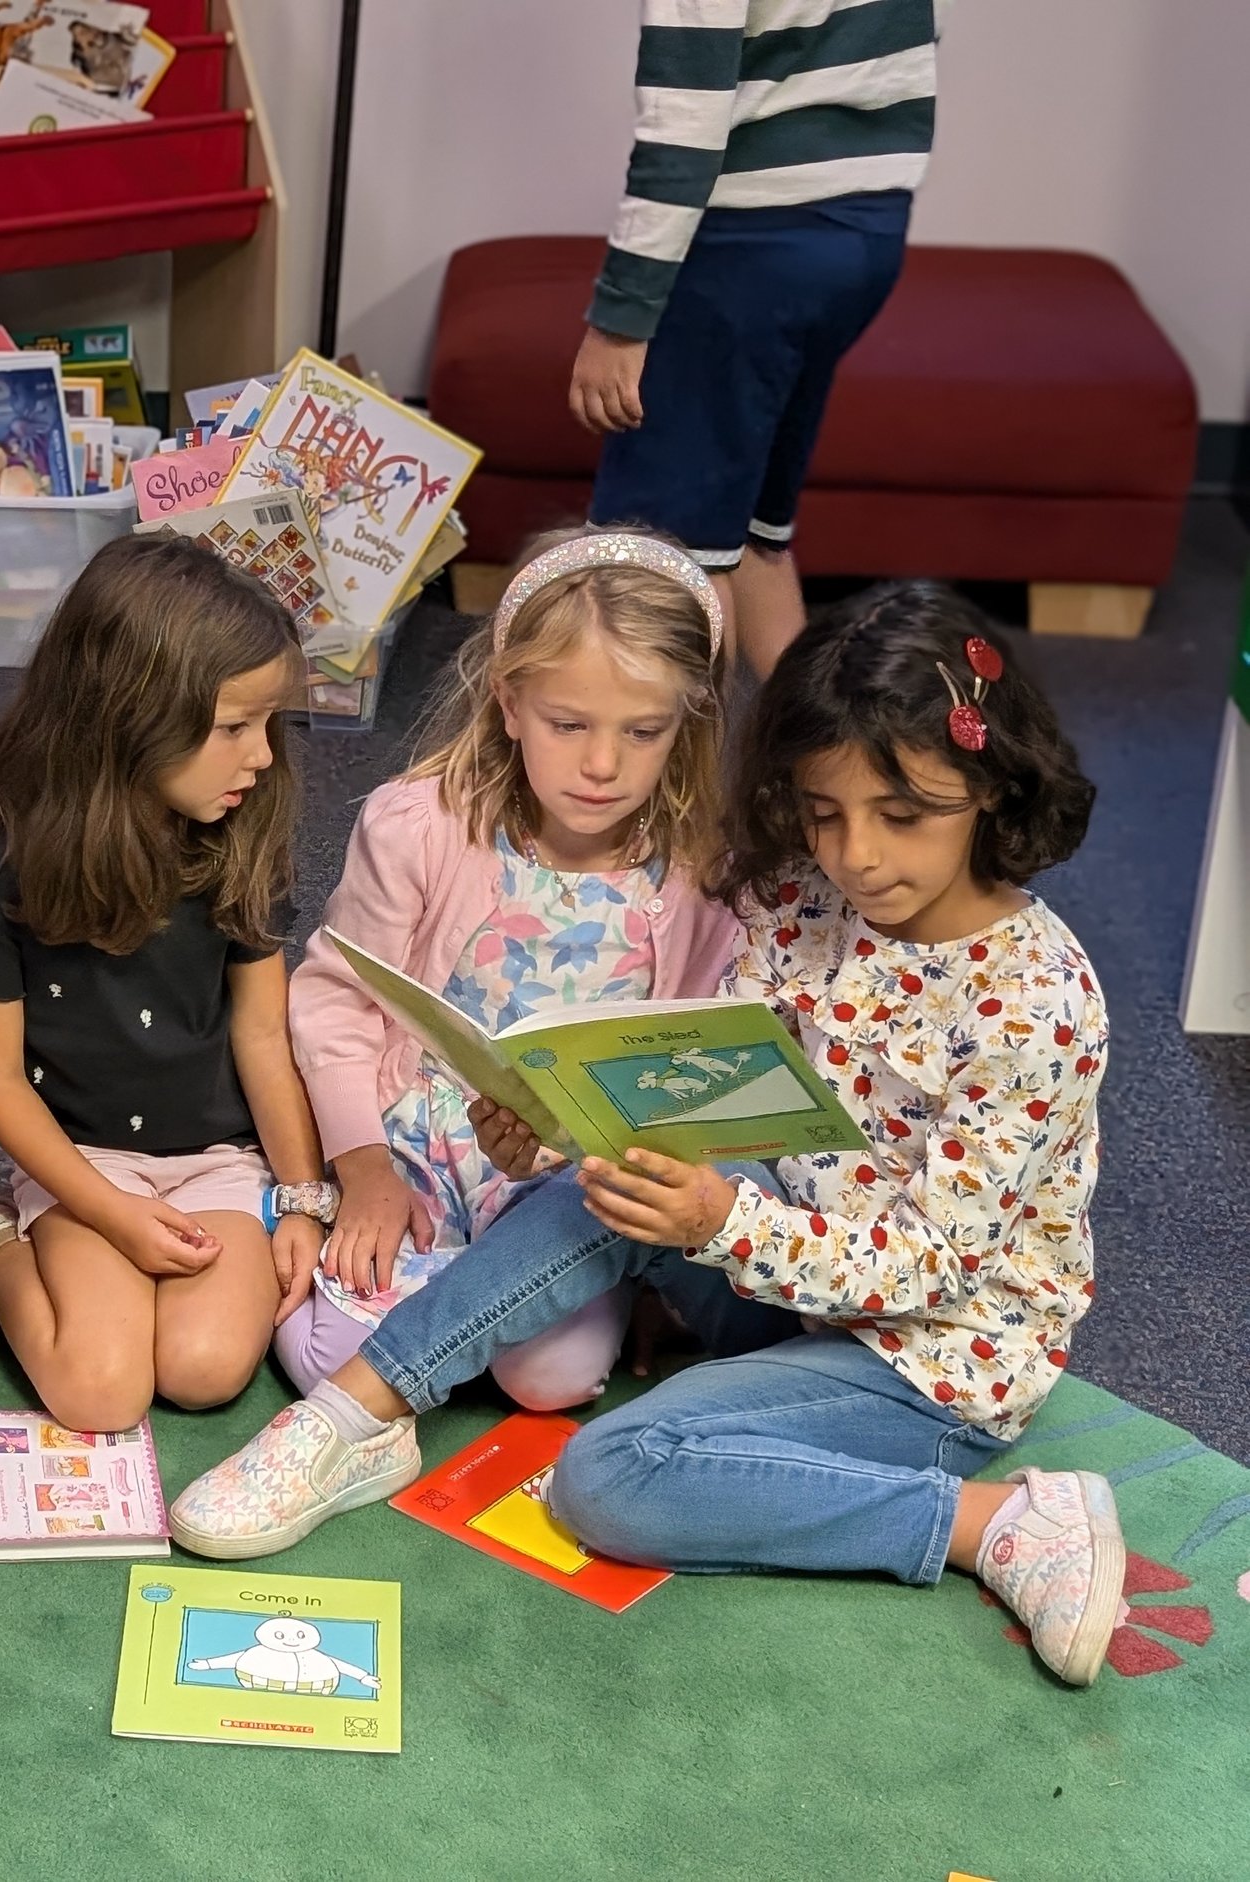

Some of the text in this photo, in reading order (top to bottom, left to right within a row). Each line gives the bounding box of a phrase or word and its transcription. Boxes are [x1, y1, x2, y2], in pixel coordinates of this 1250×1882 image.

[299, 366, 363, 409] Fancy
[618, 1029, 702, 1045] The Sled
[239, 1591, 322, 1607] Come In
